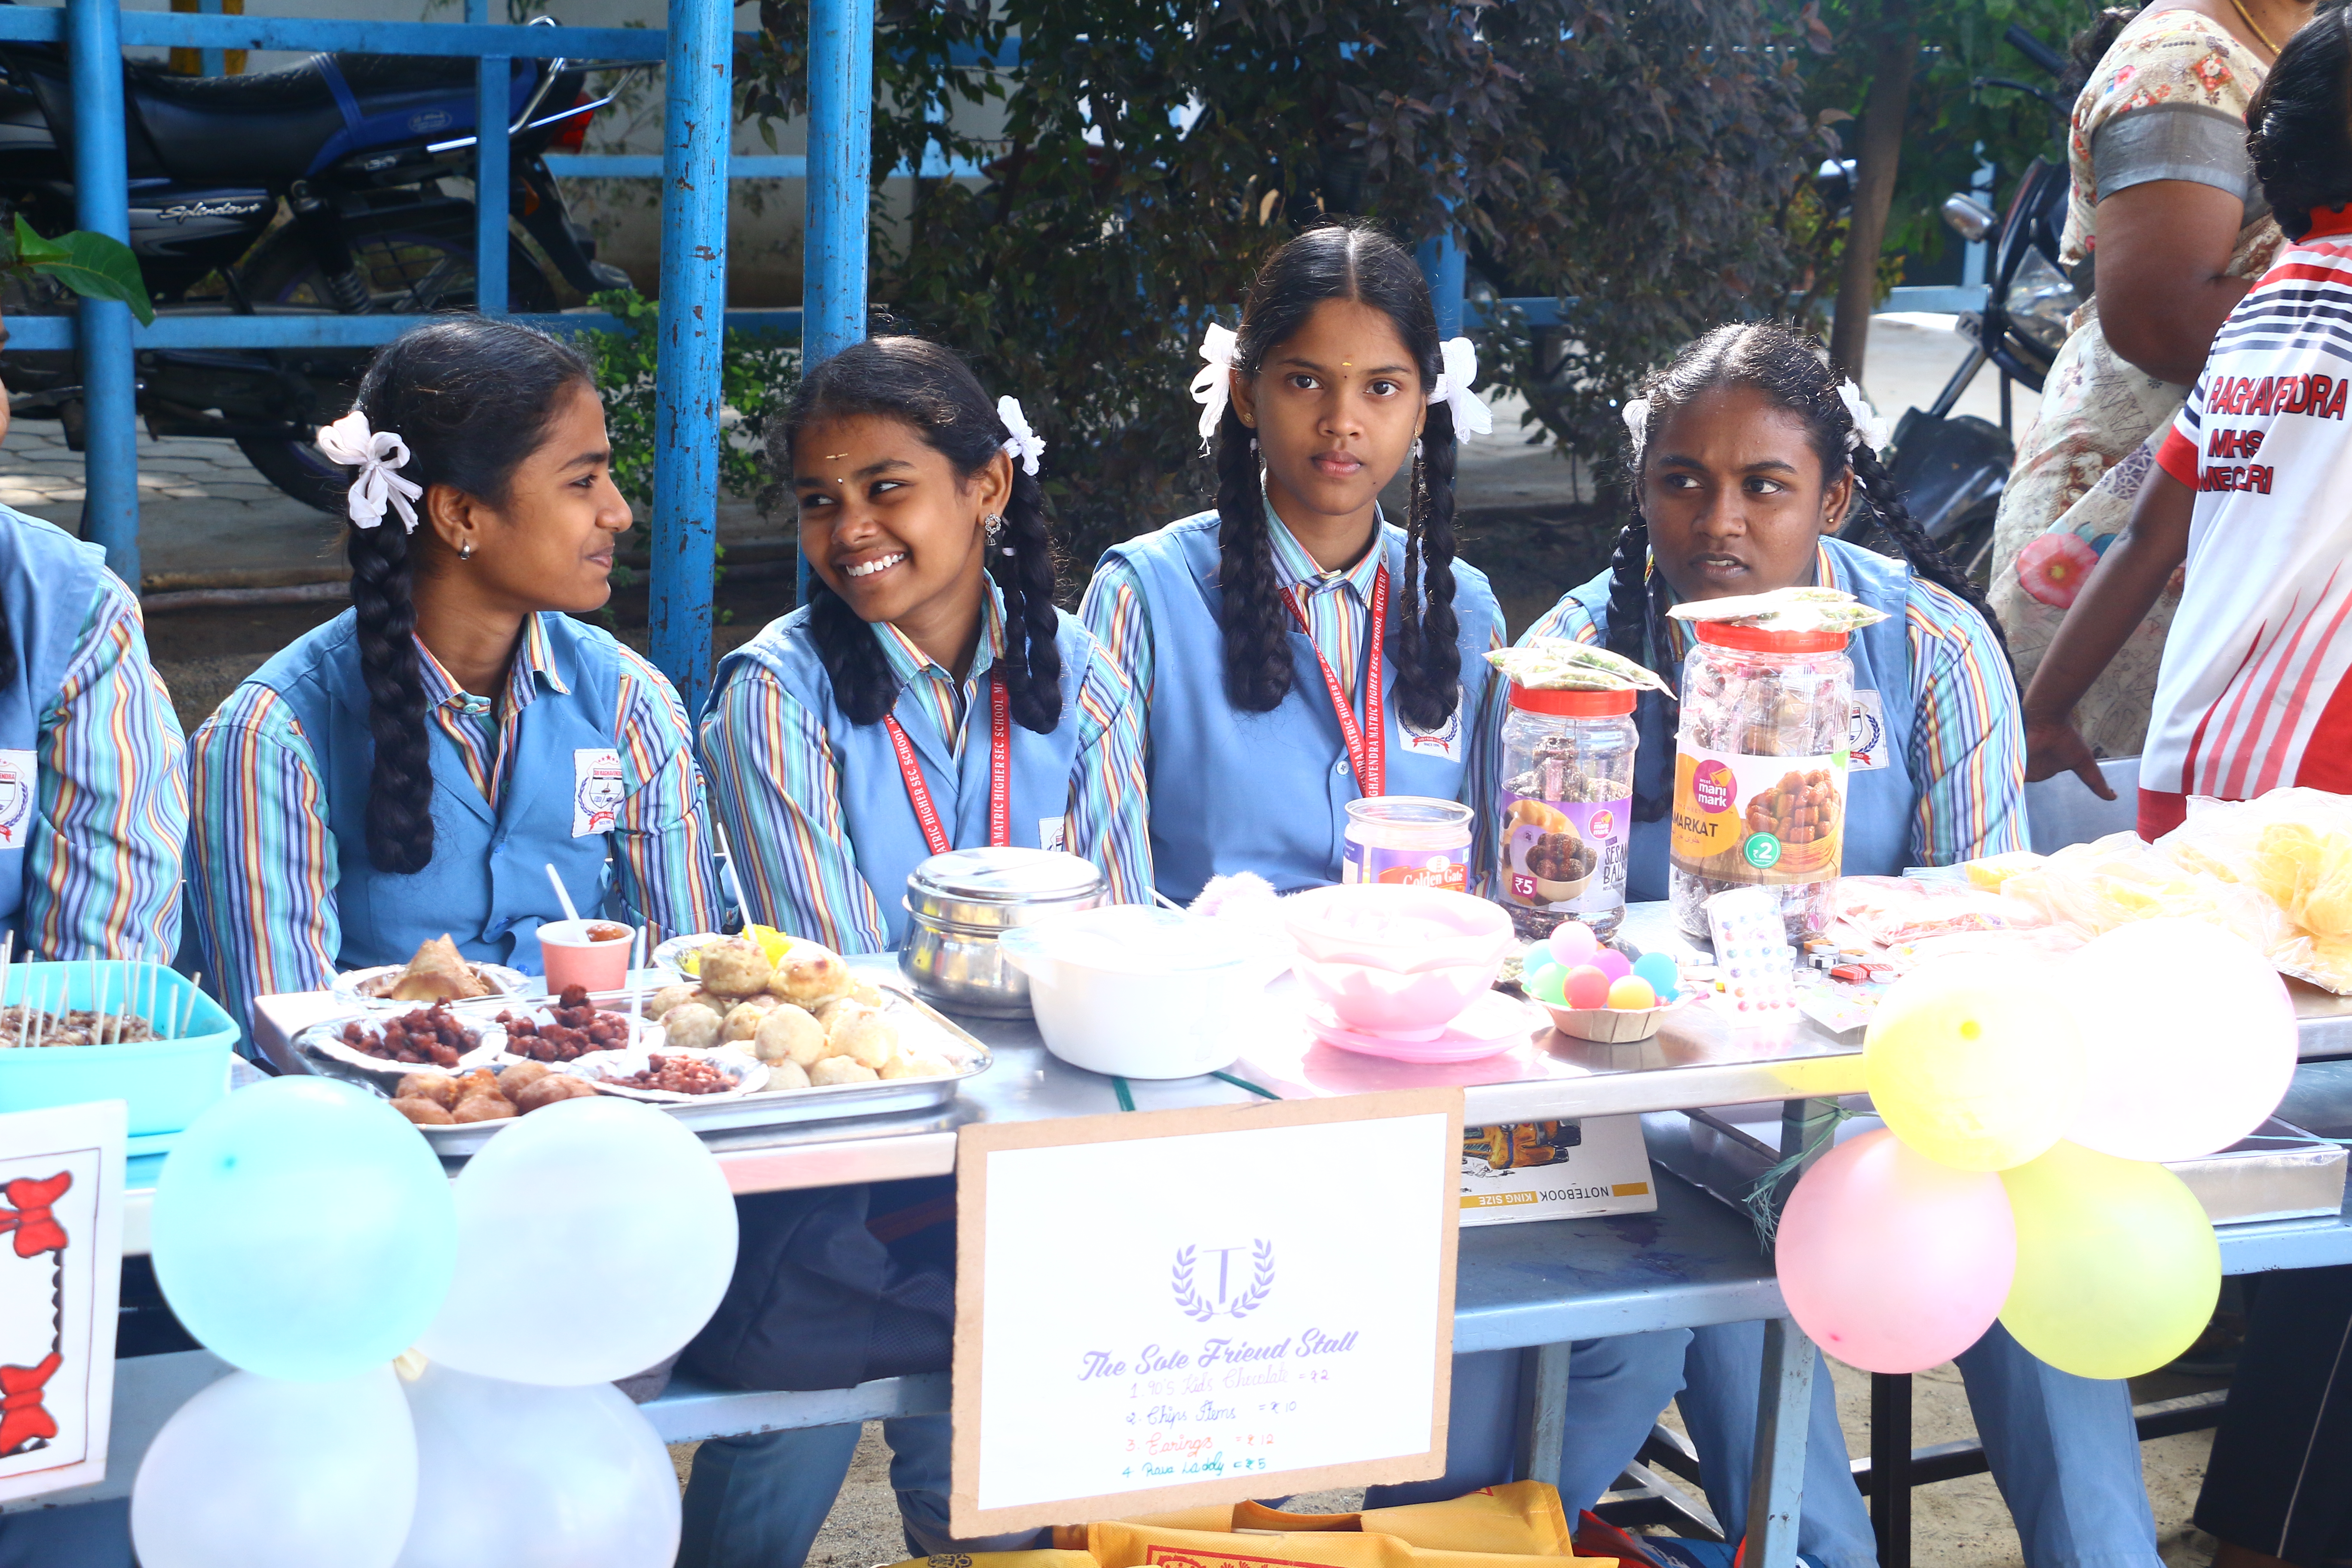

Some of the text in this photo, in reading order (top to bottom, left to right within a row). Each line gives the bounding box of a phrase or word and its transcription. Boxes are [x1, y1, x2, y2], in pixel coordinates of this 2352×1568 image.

[2205, 373, 2349, 421] RAGHAVEDRA
[2207, 429, 2265, 459] MHS
[1376, 573, 1387, 614] MECHERI
[1332, 685, 1351, 720] HIGHER
[1369, 672, 1378, 707] HIGHER
[1344, 720, 1363, 753] MATRIC
[1369, 707, 1379, 739] MATRIC
[994, 760, 1005, 802] HIGHER
[1699, 783, 1727, 796] mani
[914, 787, 935, 826] HIGHER
[1698, 794, 1727, 807] mark
[993, 802, 1004, 839] MATRIC
[1403, 869, 1464, 887] Golden Gate
[1514, 876, 1534, 894] ₹5
[1479, 1186, 1610, 1206] NOTEBOOK KING SIZE
[1078, 1327, 1360, 1381] The Sole Friend Stall
[1181, 1371, 1213, 1395] Kids
[1223, 1361, 1289, 1389] Chocolate
[1146, 1405, 1188, 1429] Chips
[1196, 1400, 1237, 1422] Items
[1145, 1432, 1213, 1458] Earings
[1141, 1462, 1175, 1478] Rava
